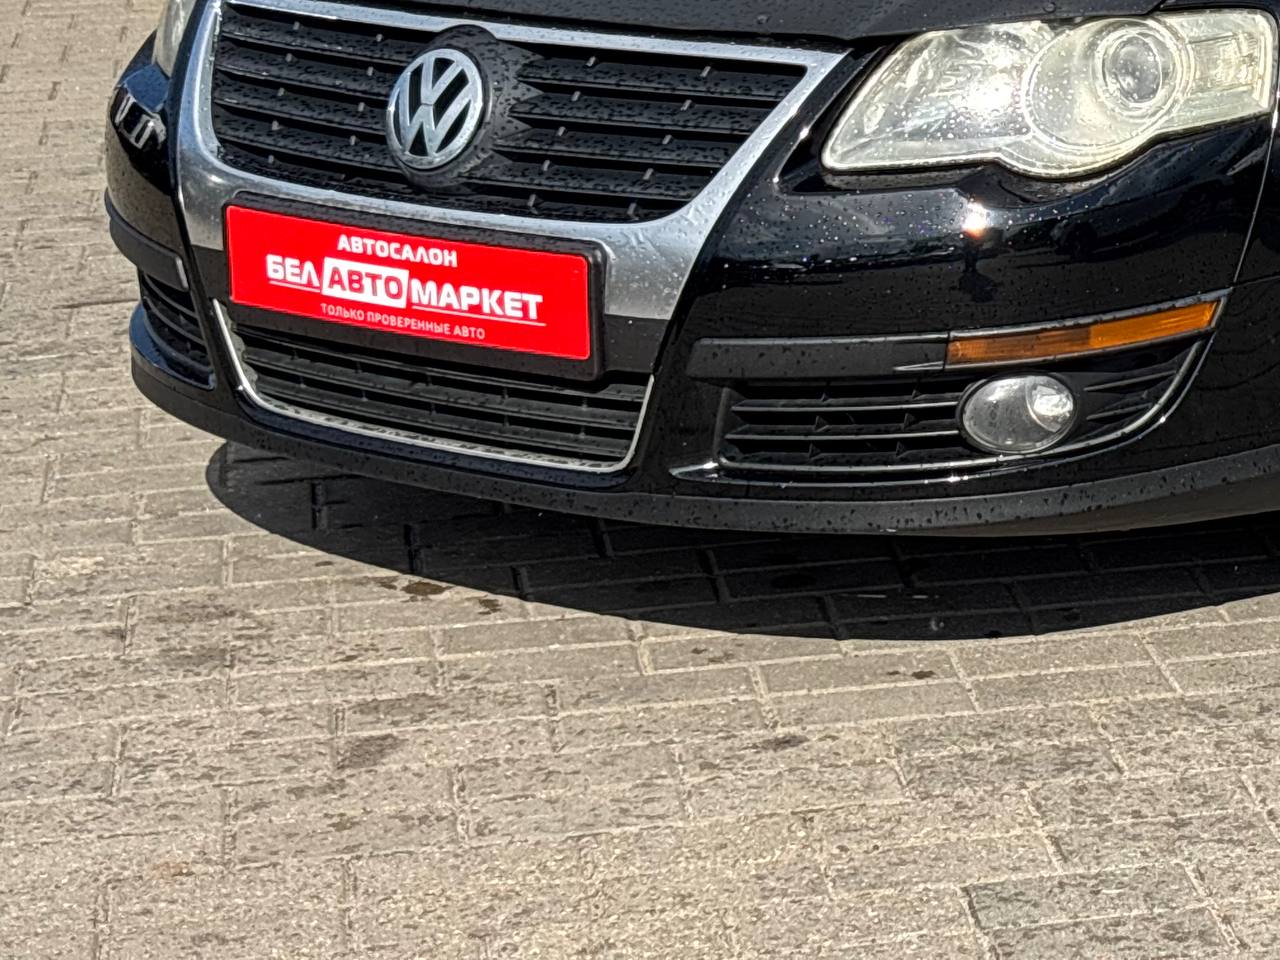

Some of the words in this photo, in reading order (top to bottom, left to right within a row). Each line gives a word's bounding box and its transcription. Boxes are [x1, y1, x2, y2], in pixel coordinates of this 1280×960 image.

[337, 234, 458, 268] АВТОСАЛОН
[320, 302, 365, 321] ТОЛЬКО
[367, 311, 451, 335] ПРОВЕРЕННЫЕ
[453, 324, 486, 340] АВТО
